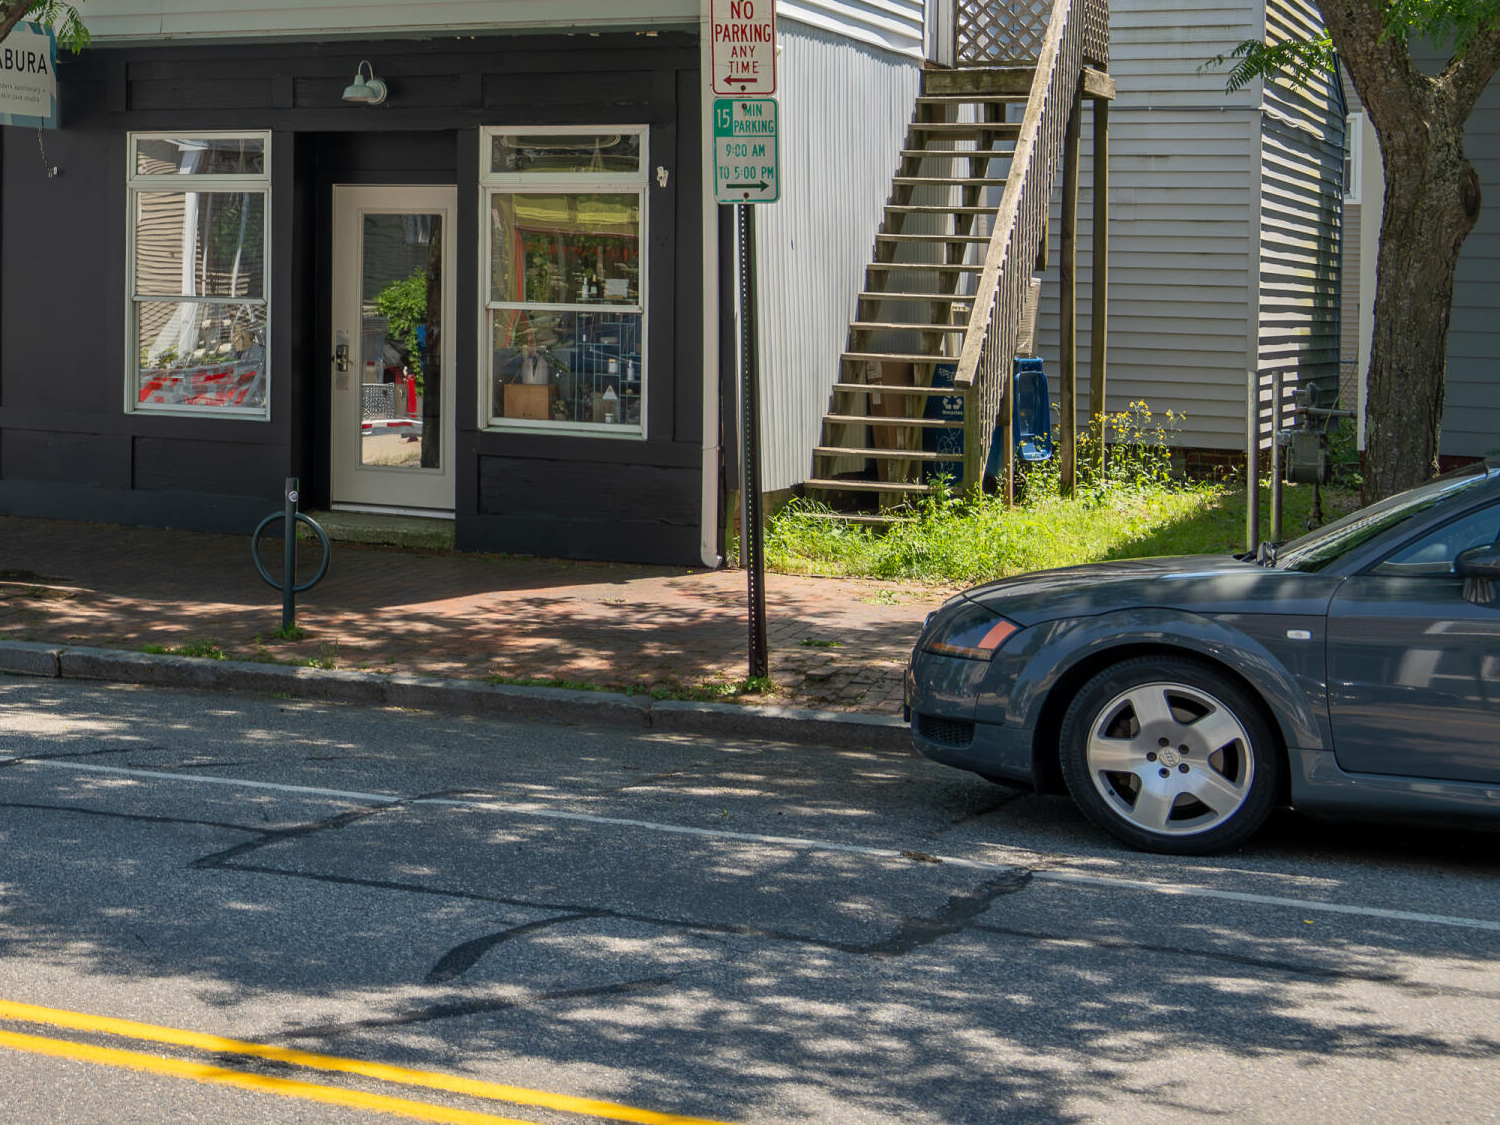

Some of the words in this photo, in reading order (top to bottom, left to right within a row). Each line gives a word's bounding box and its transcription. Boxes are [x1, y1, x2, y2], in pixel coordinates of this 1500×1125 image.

[730, 1, 754, 20] NO
[715, 23, 771, 43] PARKING
[731, 45, 756, 58] ANY
[728, 61, 759, 74] TIME
[743, 104, 762, 116] MIN
[717, 108, 730, 128] 15
[734, 120, 774, 133] PARKING
[725, 144, 747, 157] 9:00
[751, 144, 765, 157] AM
[719, 166, 729, 179] TO
[734, 166, 756, 179] 5:00
[761, 166, 774, 179] PM
